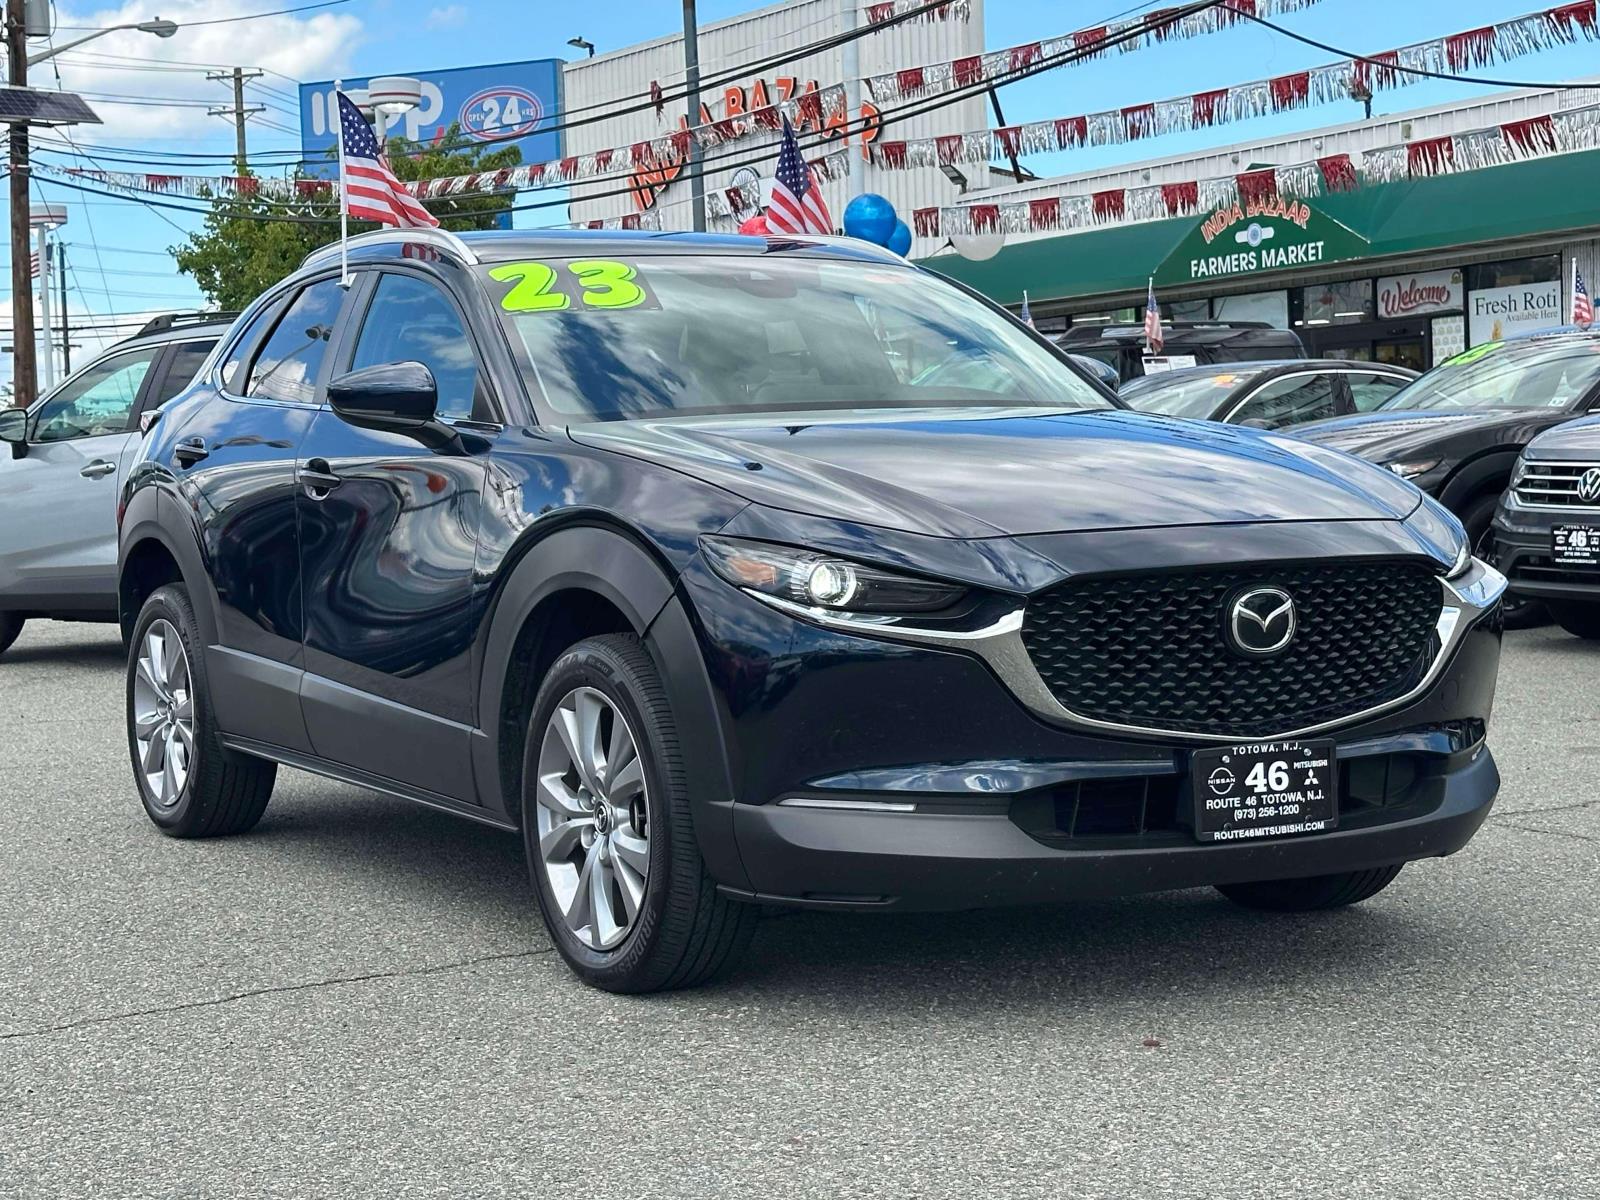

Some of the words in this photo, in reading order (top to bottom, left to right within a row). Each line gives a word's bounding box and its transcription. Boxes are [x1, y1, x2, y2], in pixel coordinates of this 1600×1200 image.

[482, 95, 521, 133] 24
[1200, 201, 1244, 244] INDIA
[1246, 197, 1311, 229] BAZAAR
[1190, 251, 1257, 278] FARMERS
[1261, 241, 1325, 268] MARKET
[488, 260, 647, 312] 23
[1381, 278, 1450, 316] Welcome
[1475, 292, 1518, 316] Fresh
[1523, 288, 1557, 311] Roti
[1505, 310, 1539, 323] Available
[1540, 309, 1558, 319] Here
[1568, 530, 1587, 547] 46
[1232, 743, 1279, 755] TOTOWA,
[1283, 742, 1302, 751] N.J.
[1293, 759, 1328, 769] MITSUBISHI
[1207, 777, 1236, 785] NISSAN
[1244, 760, 1290, 793] 46
[1206, 797, 1241, 810] ROUTE
[1245, 795, 1257, 807] 46
[1261, 792, 1305, 805] TOTOWA,
[1307, 789, 1325, 801] N.J.
[1234, 808, 1257, 821] (973)
[1258, 804, 1300, 818] 256-1200
[1214, 821, 1325, 840] ROUTE46MITSUBISHI.COM
